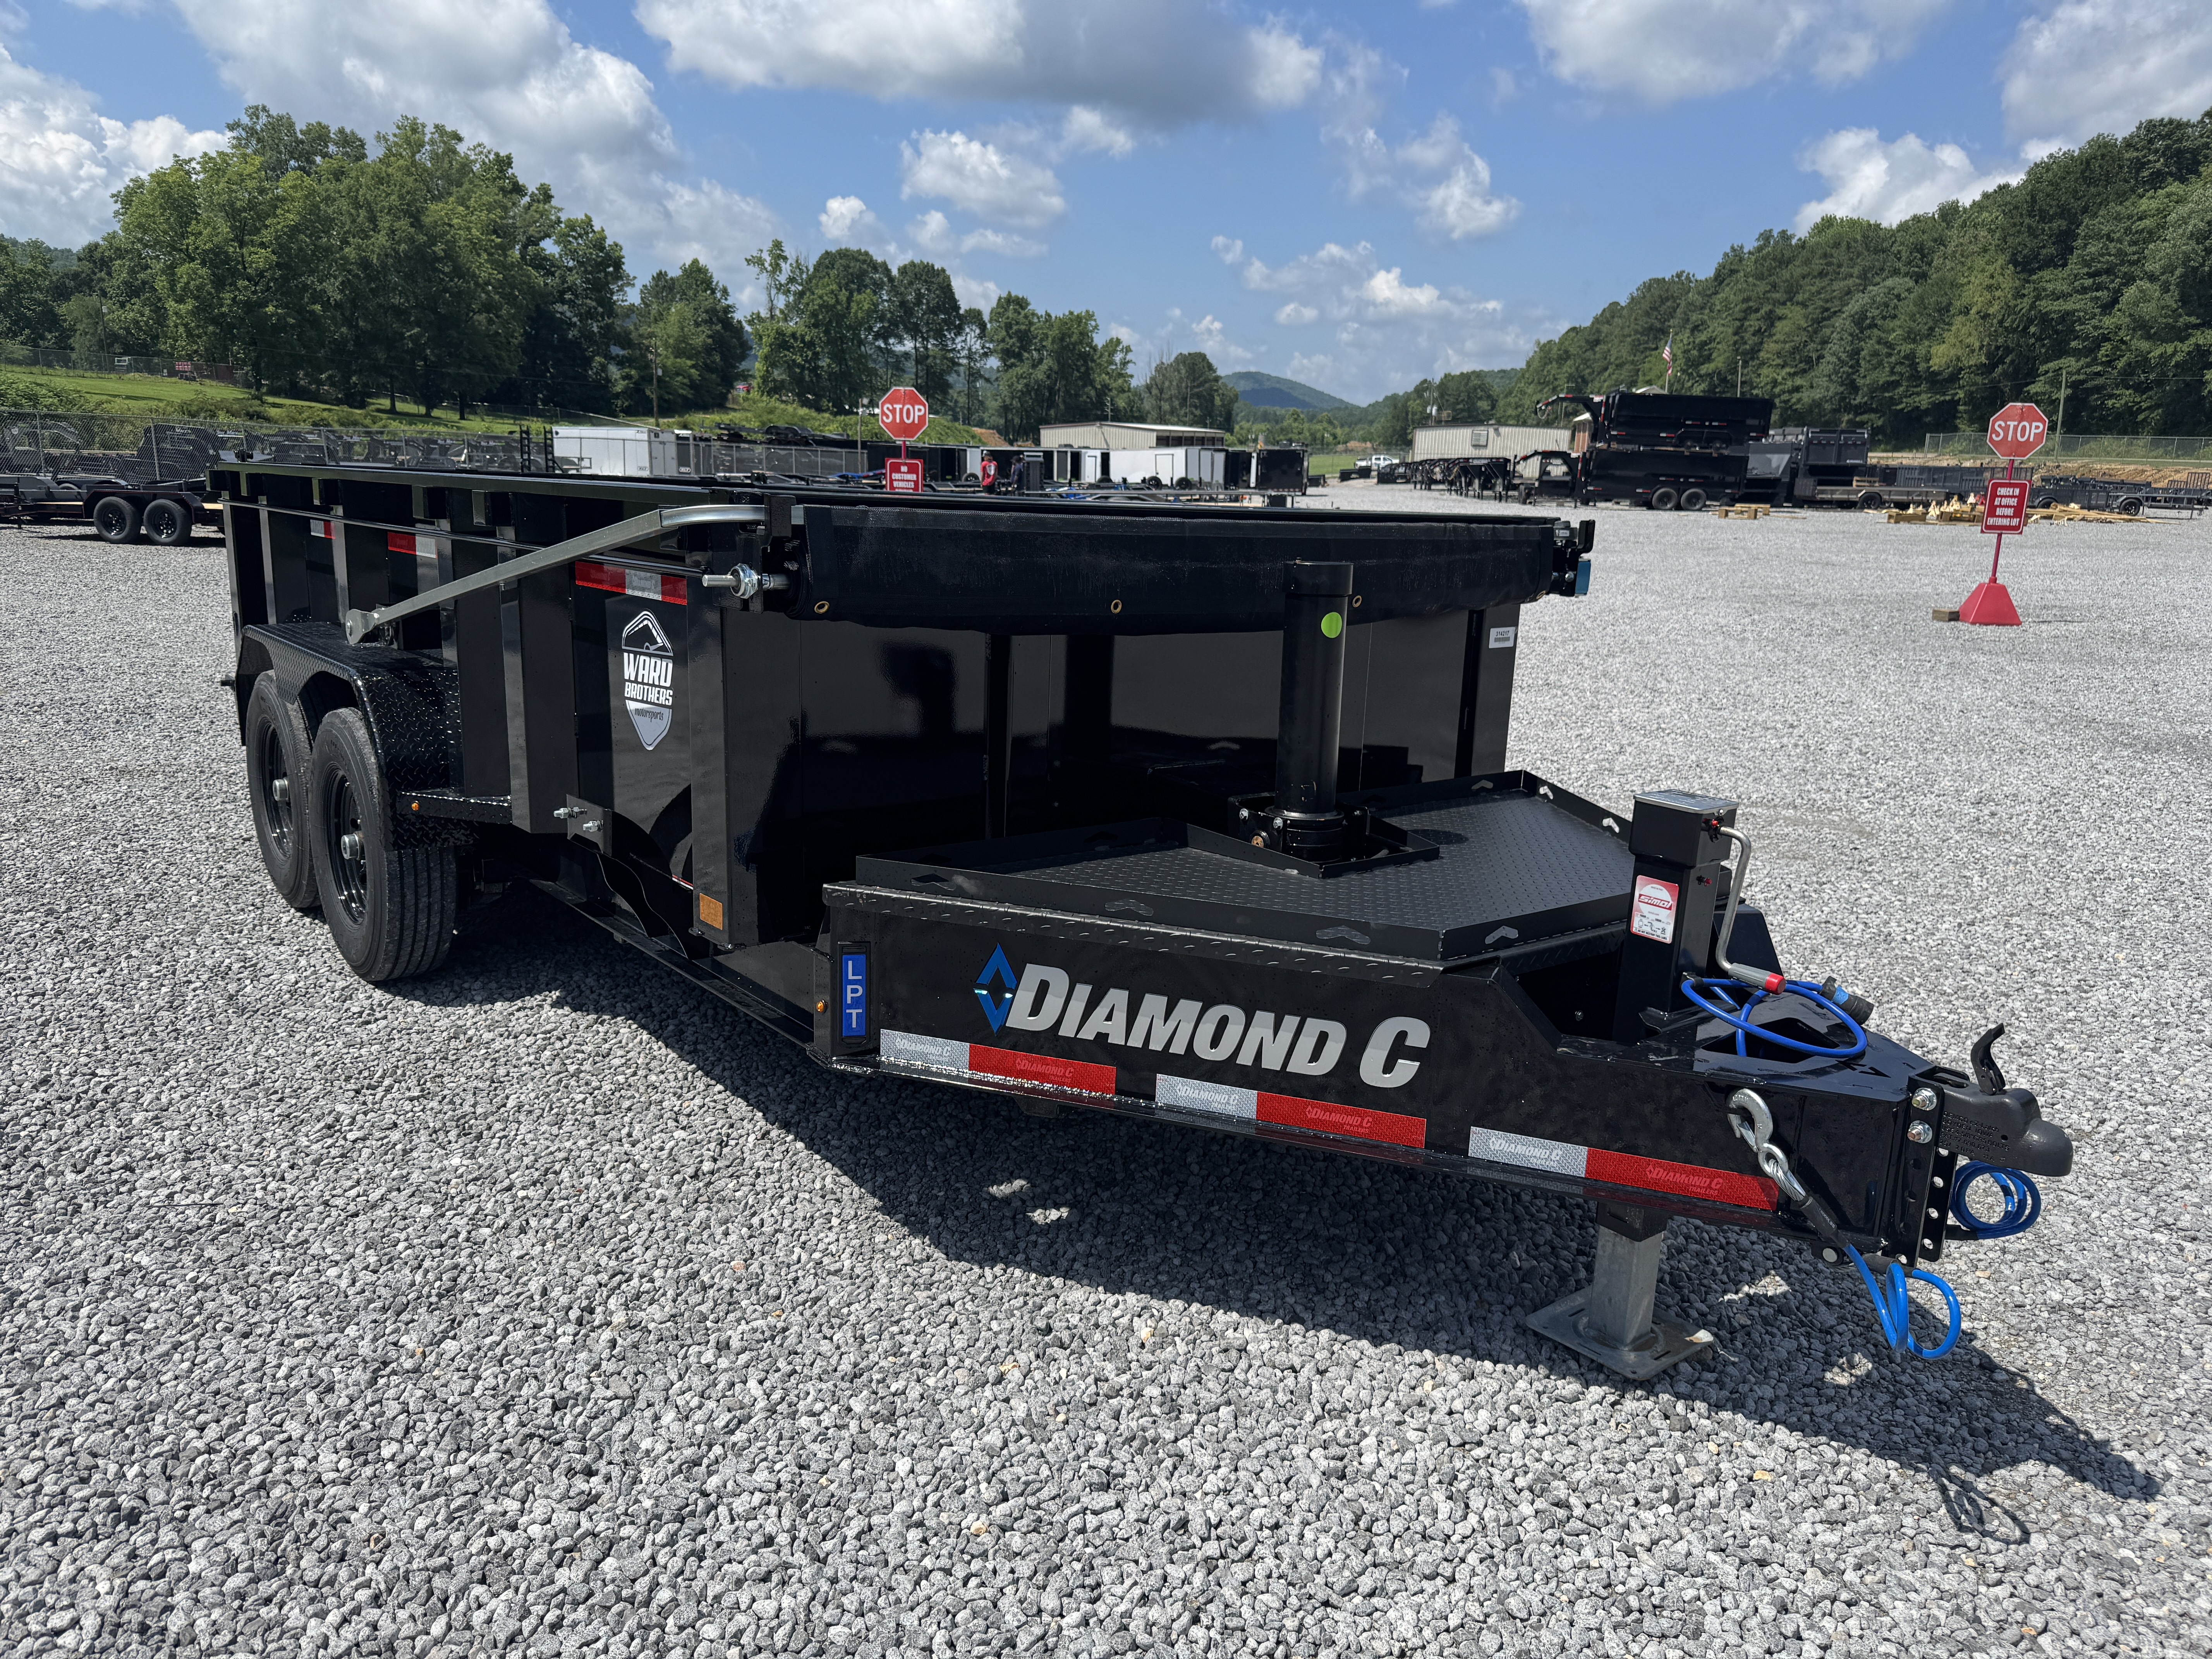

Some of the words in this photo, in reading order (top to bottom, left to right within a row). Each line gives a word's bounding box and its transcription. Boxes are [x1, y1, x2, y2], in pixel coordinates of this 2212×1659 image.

[882, 404, 925, 424] STOP
[1992, 421, 2044, 442] STOP
[1997, 487, 2014, 496] CHECK
[2014, 488, 2020, 496] IN
[1994, 497, 2001, 505] AT
[2001, 498, 2018, 506] OFFICE
[1996, 507, 2014, 516] BEFORE
[1987, 517, 2010, 526] ENTERING
[623, 652, 673, 687] WARD
[624, 682, 673, 706] BROTHERS
[635, 708, 664, 723] motorsports
[846, 960, 863, 1028] LPT
[1006, 963, 1347, 1076] DIAMOND
[1359, 1016, 1431, 1088] C
[901, 1039, 942, 1054] DIAMOND
[943, 1046, 951, 1056] C
[1020, 1060, 1064, 1075] DIAMOND
[1065, 1067, 1074, 1077] C
[1049, 1075, 1072, 1083] TRAILERS
[1182, 1085, 1228, 1103] DIAMOND
[1230, 1095, 1238, 1104] C
[1310, 1108, 1361, 1125] DIAMOND
[1363, 1117, 1372, 1127] C
[1943, 1111, 1968, 1123] DEMCO
[1343, 1125, 1369, 1133] TRAILERS
[1975, 1128, 1993, 1138] IOWA
[1494, 1139, 1549, 1158] DIAMOND
[1551, 1150, 1562, 1160] C
[1988, 1139, 2010, 1151] BOLTS
[1652, 1168, 1710, 1187] DIAMOND
[1711, 1178, 1723, 1189] C
[1689, 1186, 1718, 1195] TRAILERS
